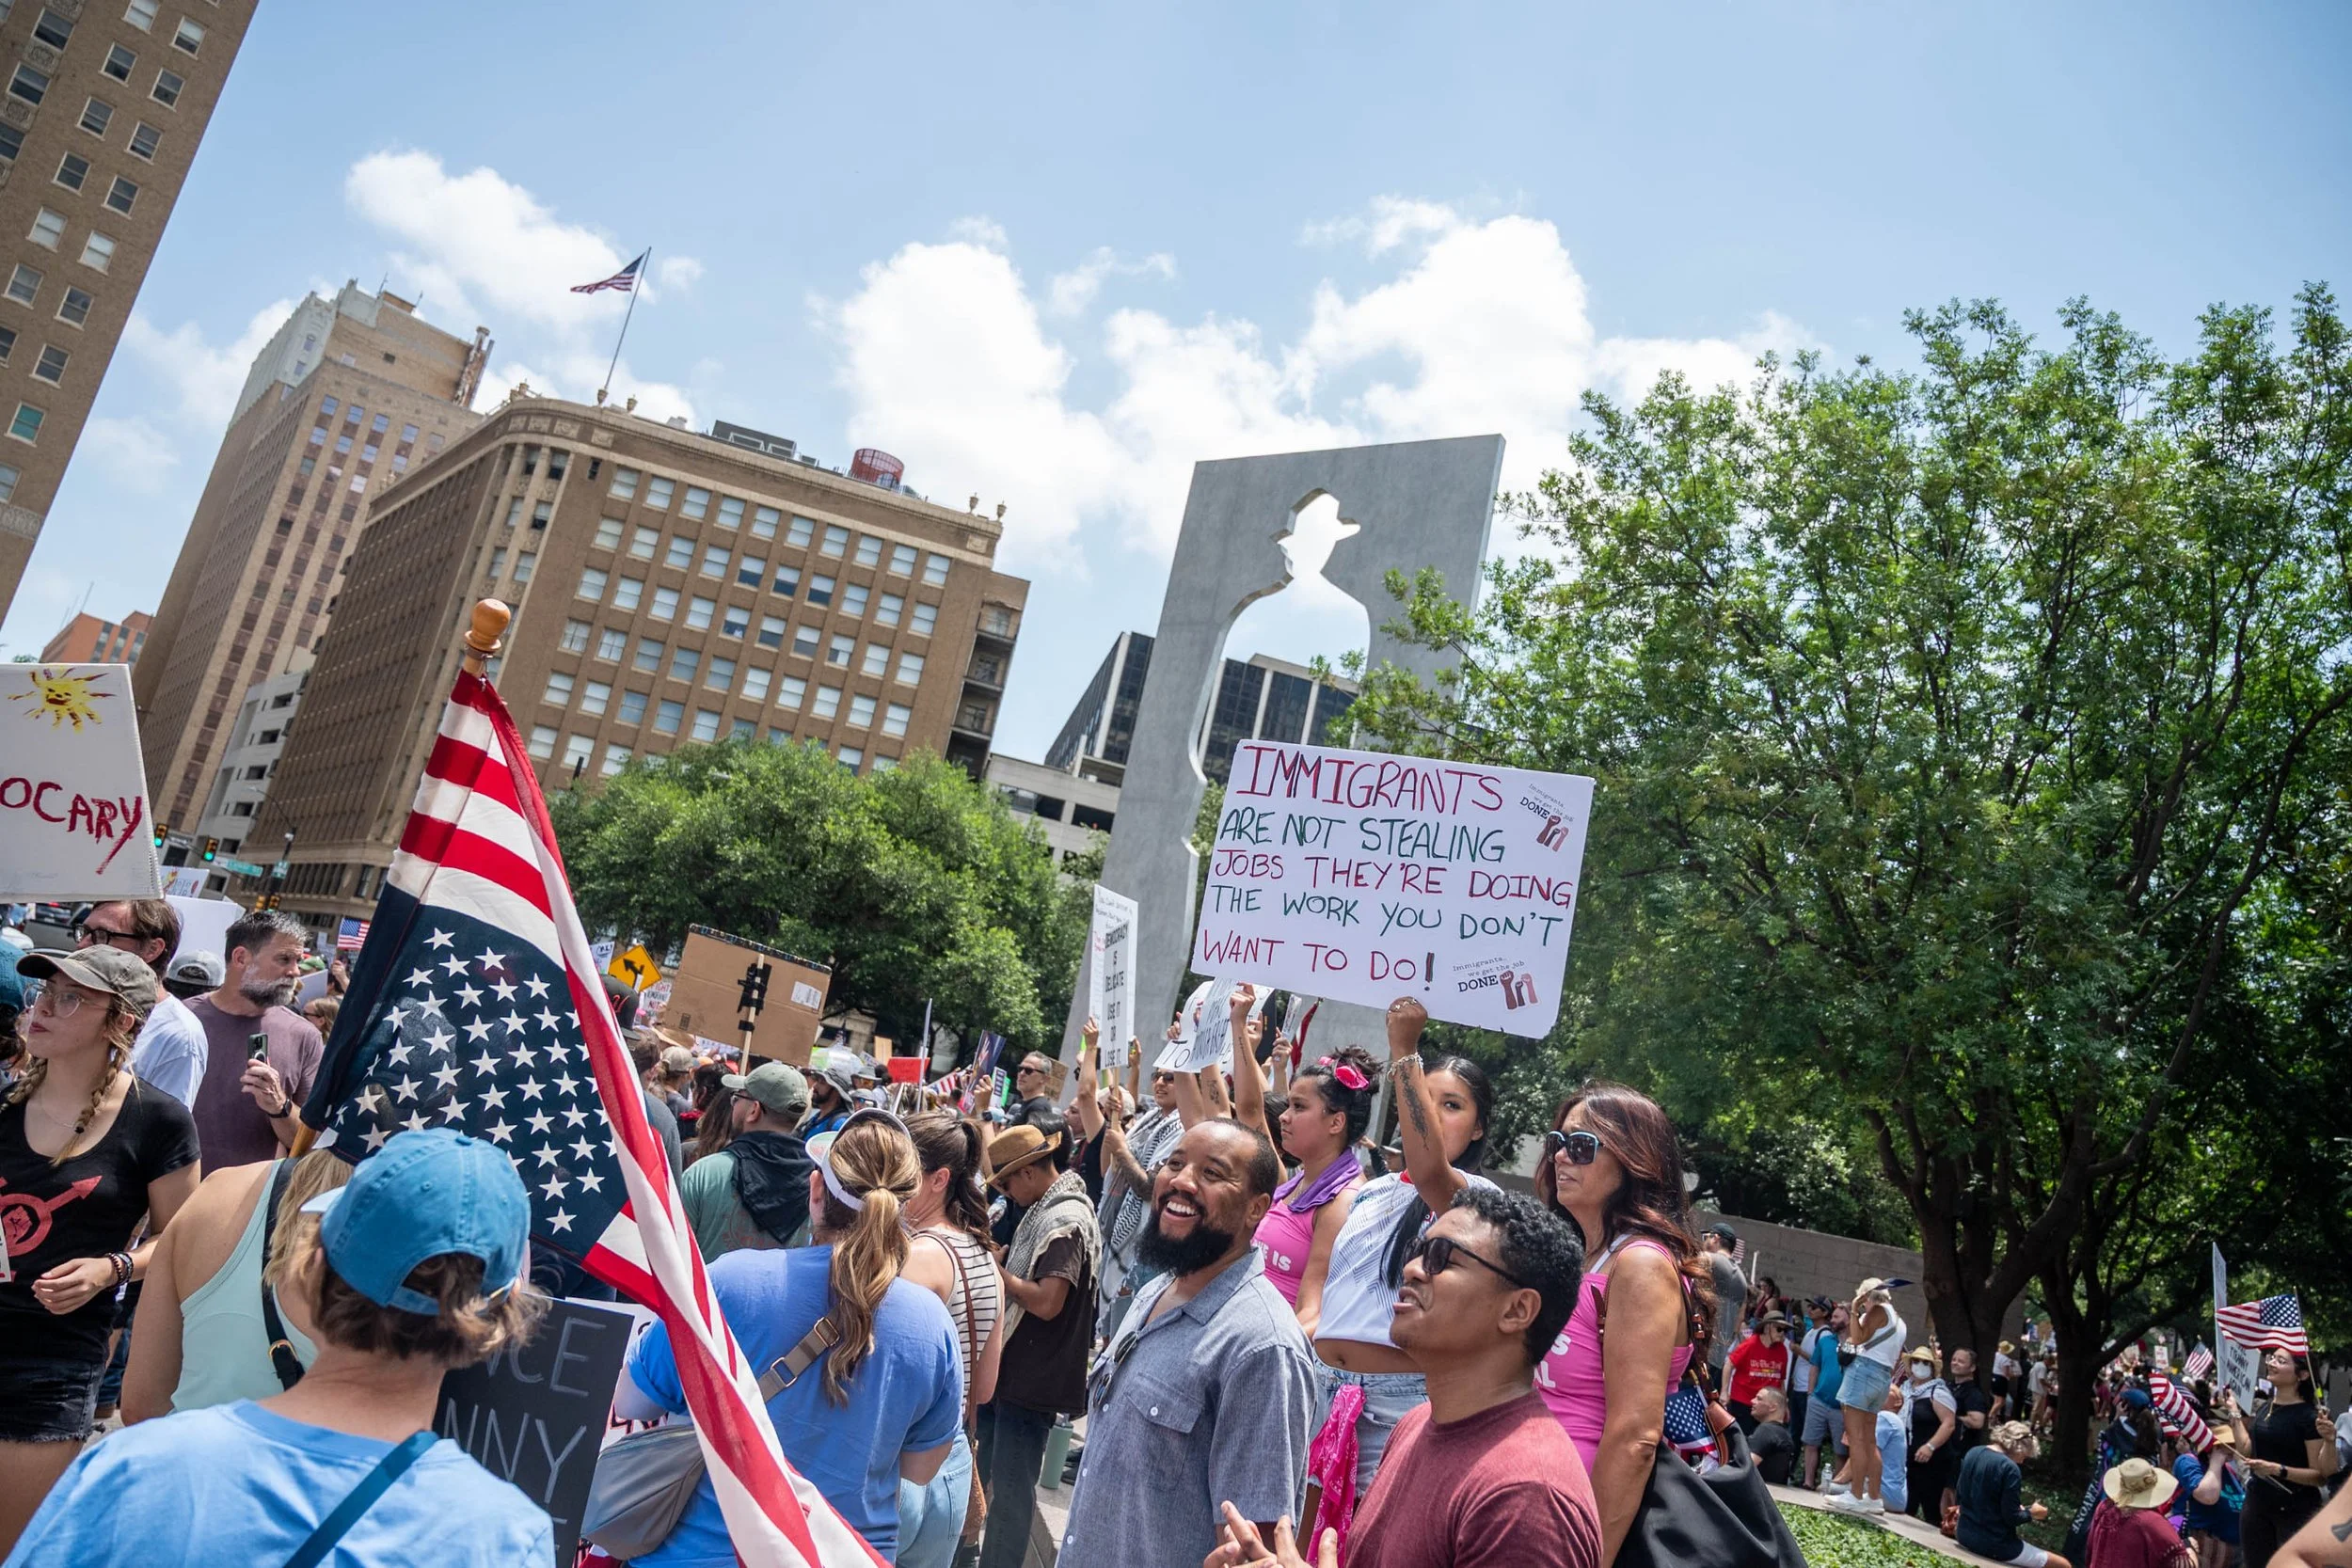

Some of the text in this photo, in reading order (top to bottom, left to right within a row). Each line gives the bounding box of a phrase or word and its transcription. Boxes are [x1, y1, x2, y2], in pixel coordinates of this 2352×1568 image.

[1236, 745, 1503, 816] IMMIGRANTS
[1520, 797, 1549, 819] DONE
[1219, 806, 1505, 863] ARE NOT STEALING
[1214, 848, 1574, 910] JOBS THEY'RE DOING
[1211, 885, 1564, 946] THE WORK YOU DON'T
[1203, 929, 1436, 991] WANT TO DO!
[1458, 975, 1499, 992] DONE
[1272, 1250, 1292, 1271] IS
